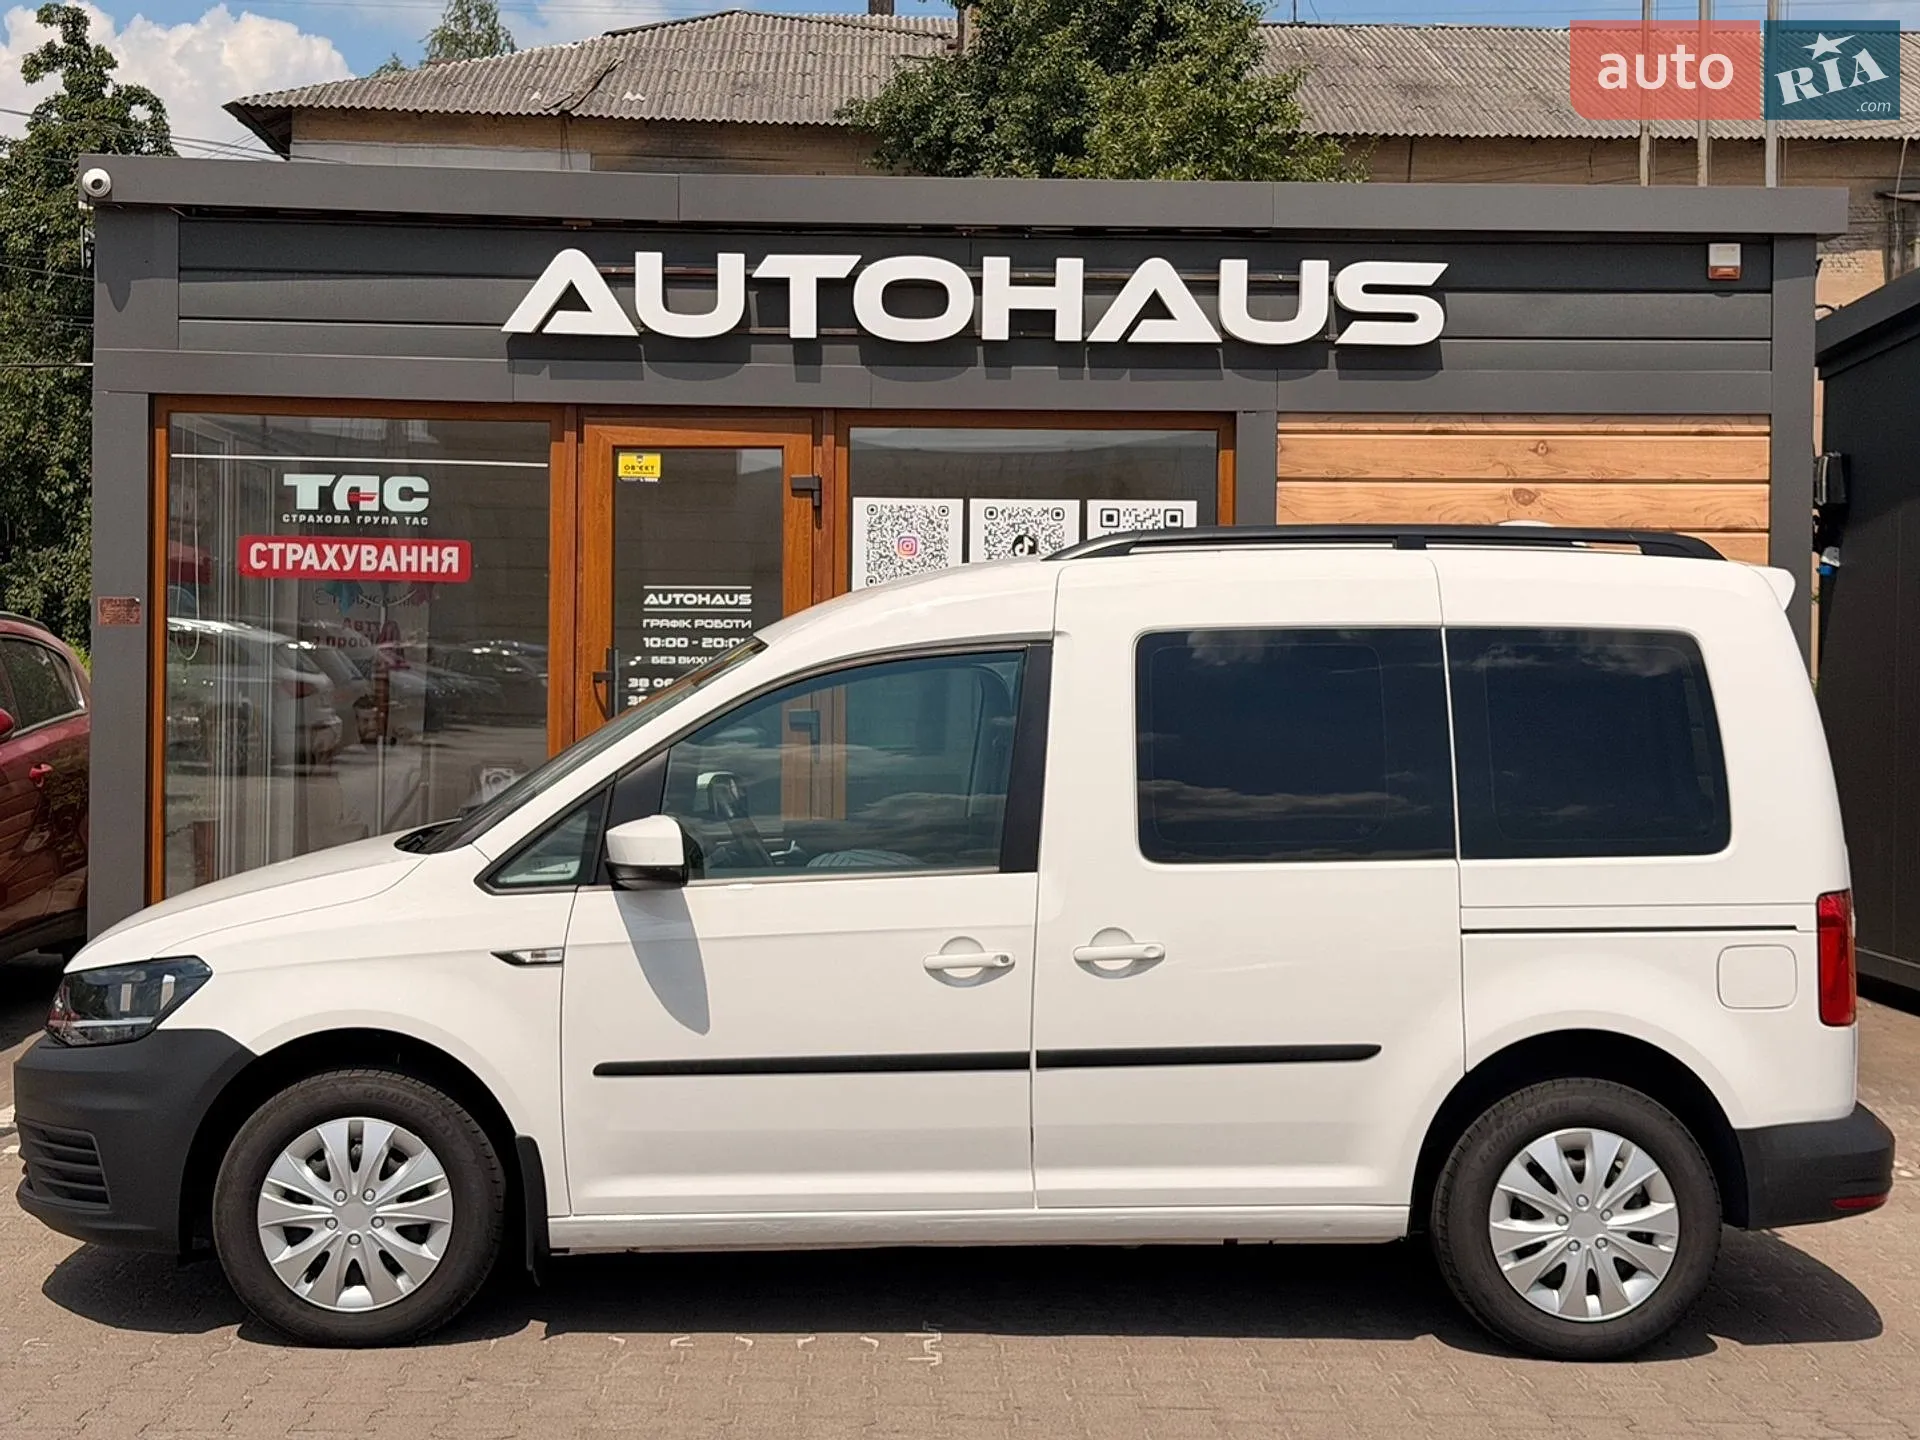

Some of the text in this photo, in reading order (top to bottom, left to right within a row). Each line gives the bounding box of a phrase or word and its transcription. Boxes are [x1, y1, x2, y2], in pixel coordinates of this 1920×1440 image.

[501, 248, 1449, 347] AUTOHAUS
[282, 513, 429, 526] СТРАХОВА ГРУПА ТАС
[249, 541, 460, 574] СТРАХУВАННЯ
[643, 593, 753, 606] AUTOHAUS
[642, 618, 753, 629] ГРАФІК РОБОТИ
[642, 636, 689, 648] 10:00
[701, 636, 745, 649] 20:0
[651, 656, 676, 665] БЕЗ
